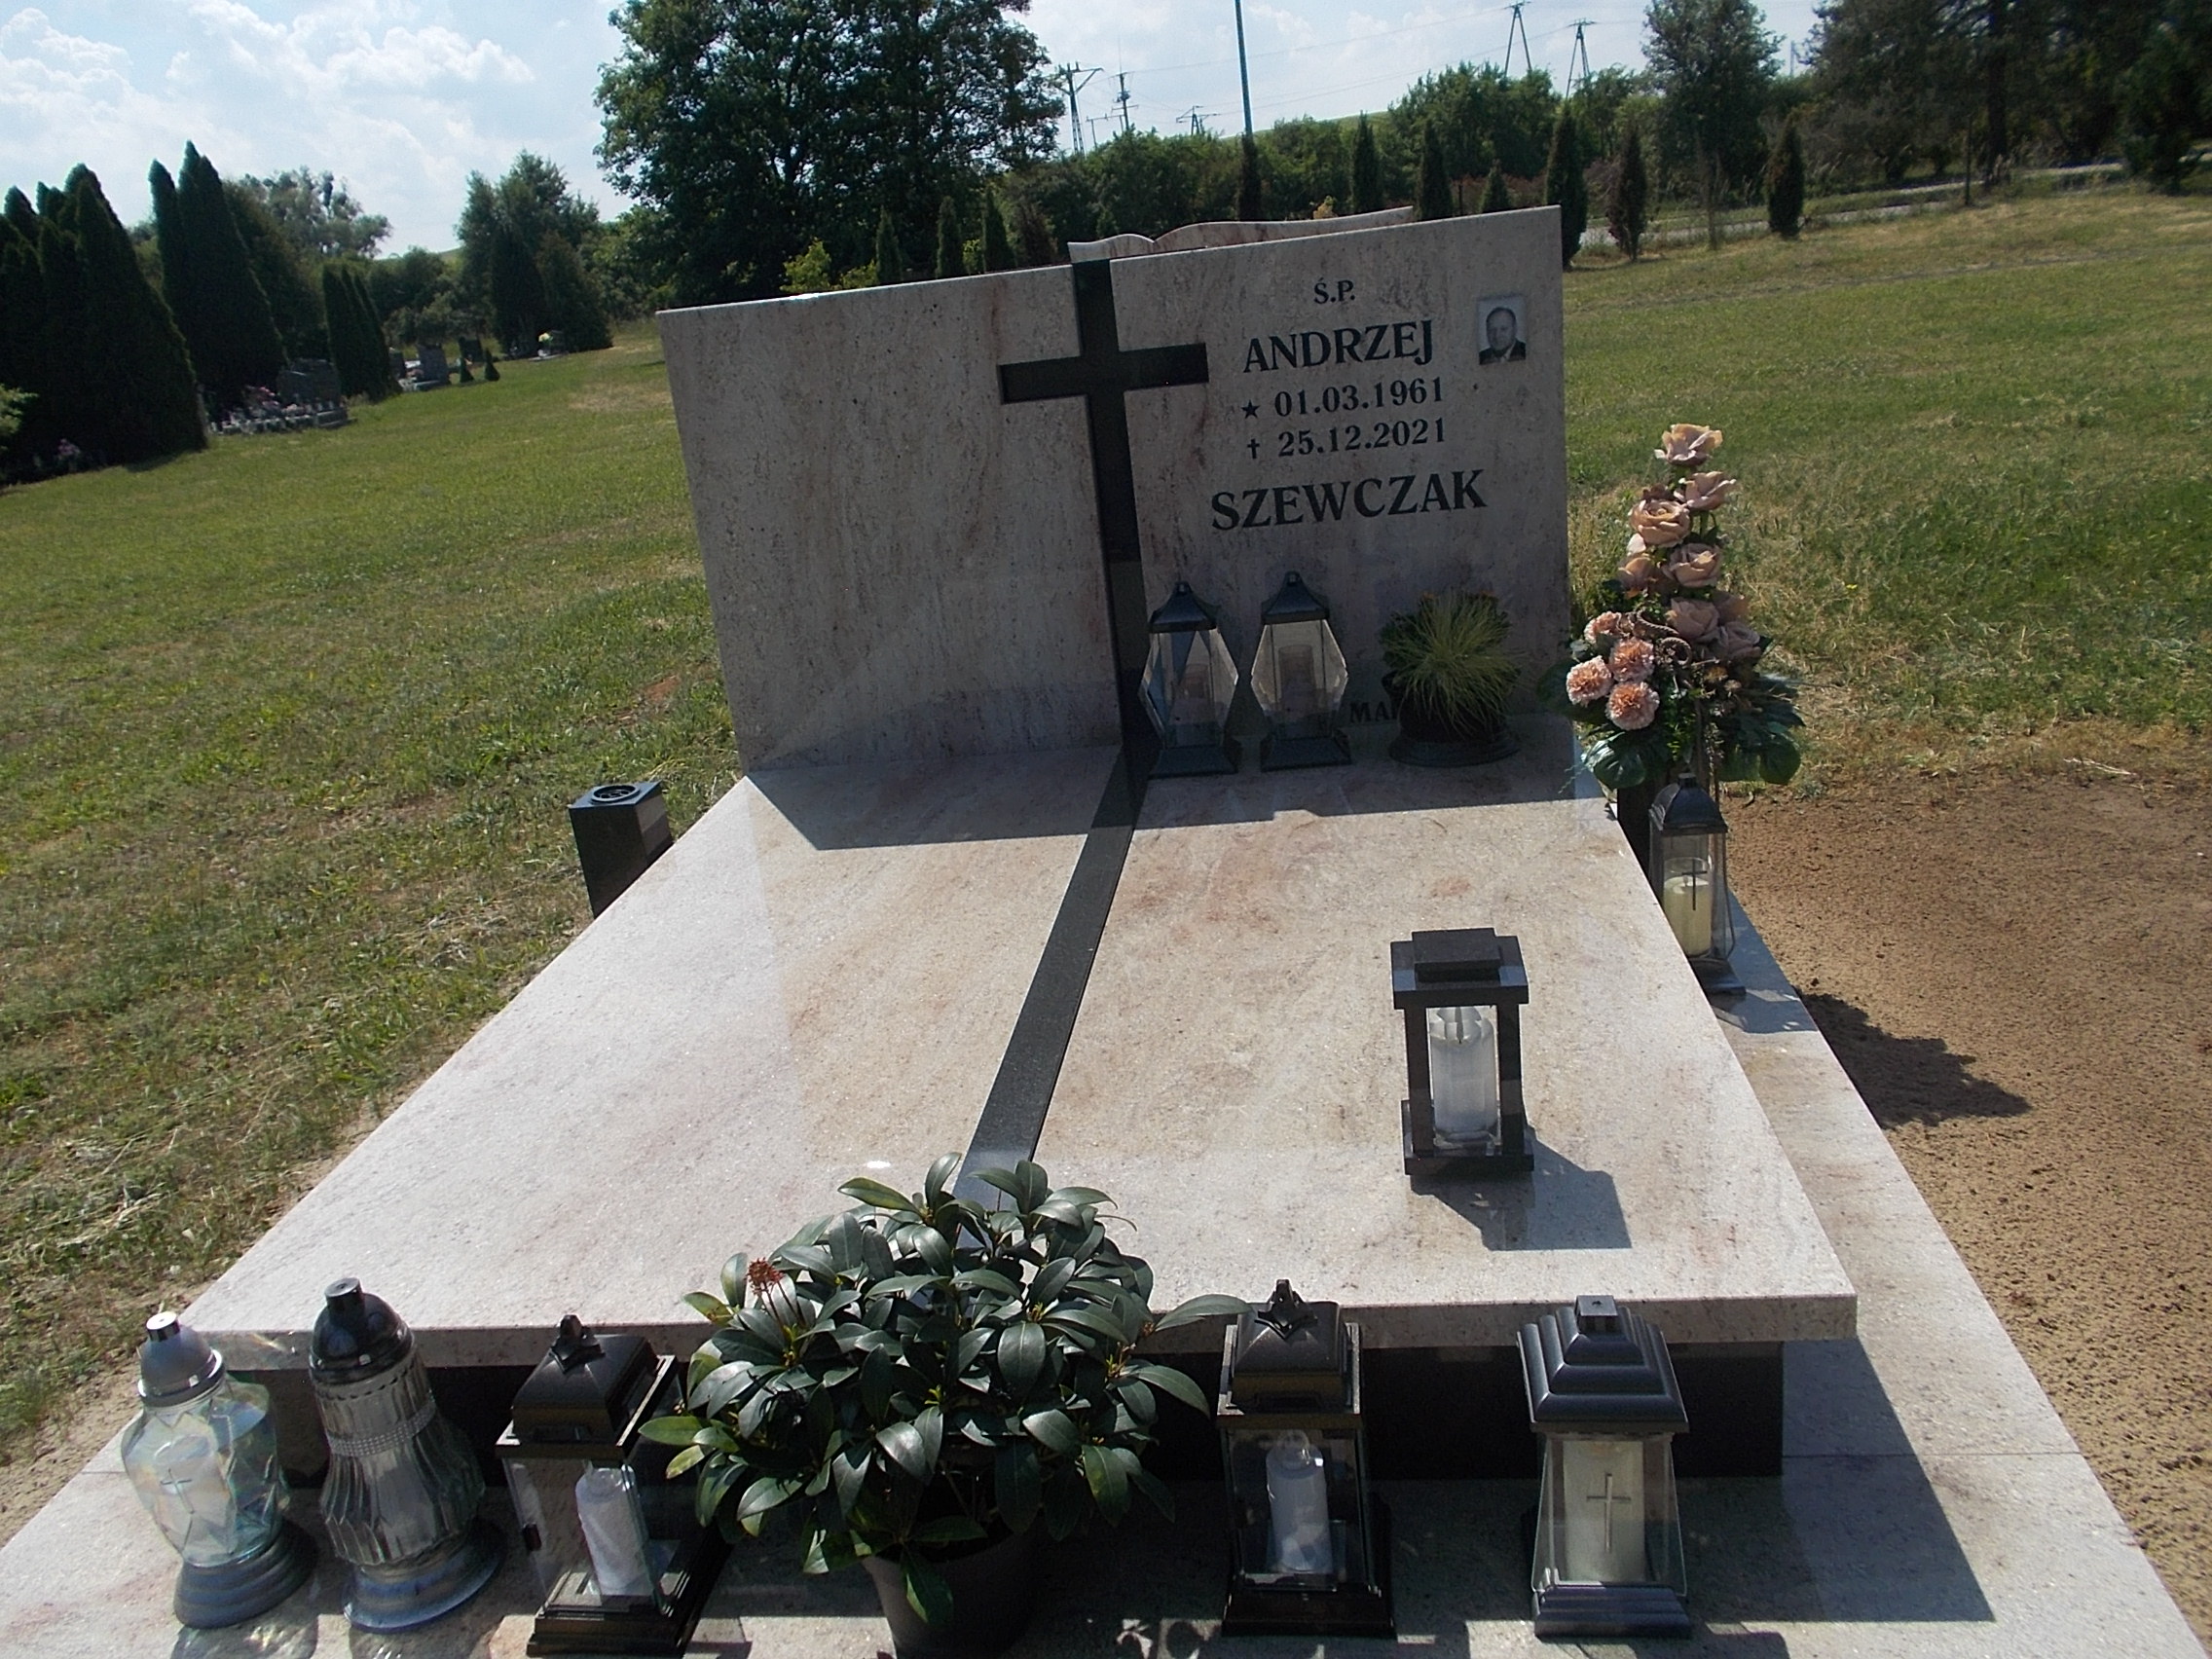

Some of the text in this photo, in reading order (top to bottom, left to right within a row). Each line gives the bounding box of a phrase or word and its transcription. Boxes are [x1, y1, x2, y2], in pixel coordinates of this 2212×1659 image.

[1313, 277, 1355, 304] Ś.P.
[1242, 319, 1432, 373] ANDRZEJ
[1273, 377, 1444, 417] 01.03.1961
[1277, 417, 1445, 458] 25.12.2021
[1211, 468, 1488, 531] SZEWCZAK
